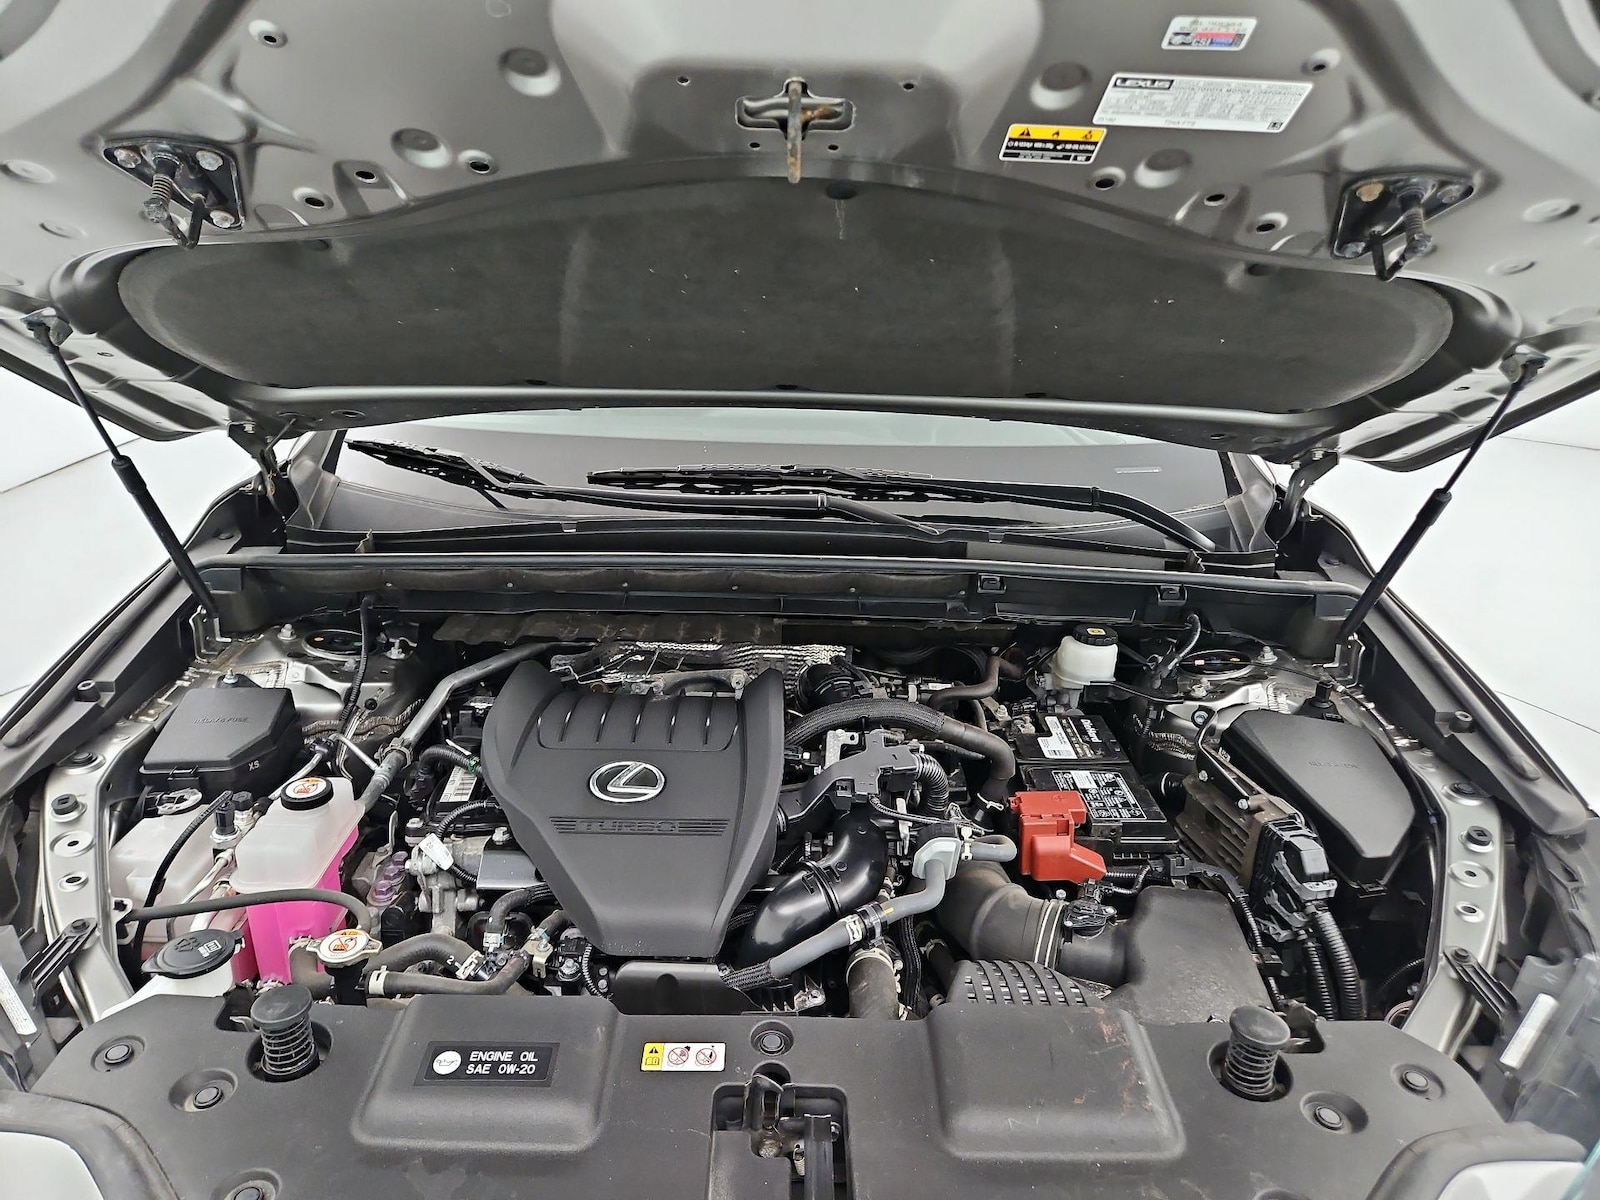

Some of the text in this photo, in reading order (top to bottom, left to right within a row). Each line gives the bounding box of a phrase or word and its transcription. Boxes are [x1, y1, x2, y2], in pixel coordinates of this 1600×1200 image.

[1115, 79, 1171, 89] LEXUS
[1081, 719, 1102, 742] DieHard
[248, 760, 260, 771] XS
[579, 820, 677, 833] TURBO
[447, 955, 455, 965] 2
[469, 1051, 539, 1062] ENGINE OIL
[466, 1064, 536, 1075] SAE 0W-20
